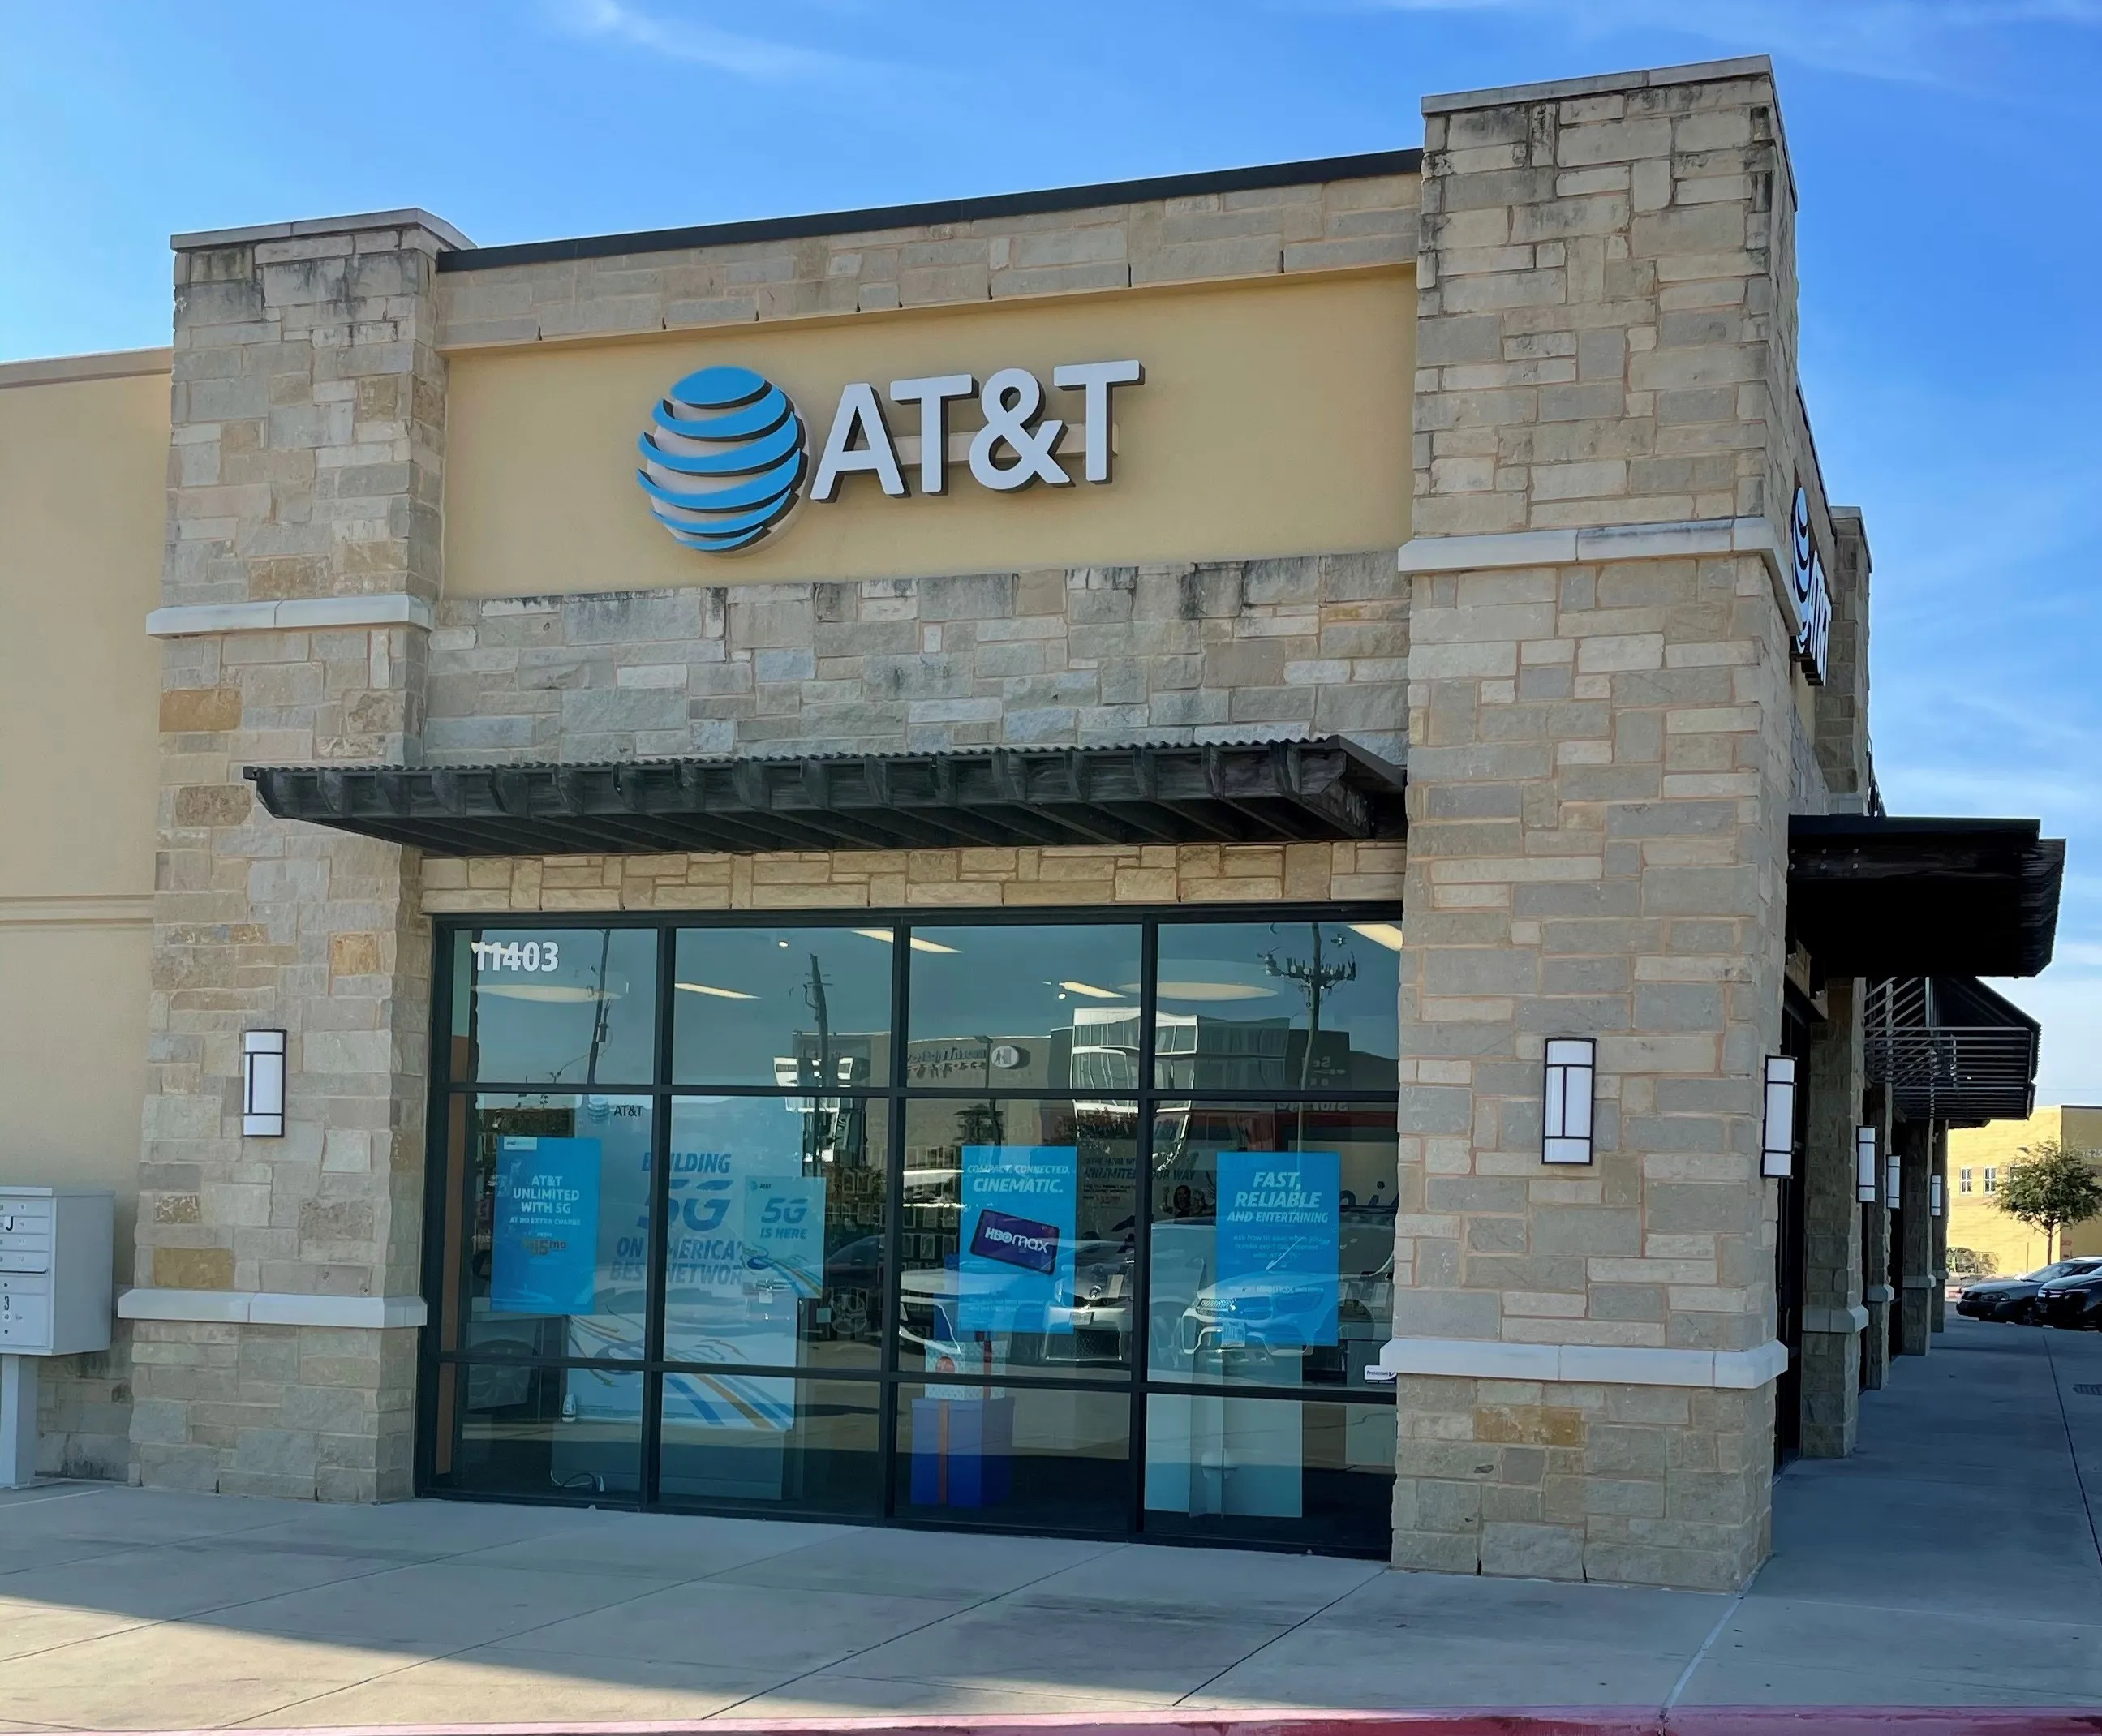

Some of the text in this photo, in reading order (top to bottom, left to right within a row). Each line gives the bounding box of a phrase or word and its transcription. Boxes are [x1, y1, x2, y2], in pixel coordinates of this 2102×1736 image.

[810, 359, 1143, 502] AT&T
[476, 941, 559, 972] 11403
[613, 1105, 643, 1117] AT&T
[642, 1152, 731, 1174] BILDING
[531, 1175, 563, 1187] AT&T
[974, 1178, 1064, 1193] CINEMATIC.
[1253, 1171, 1301, 1191] FAST,
[513, 1188, 580, 1201] UNLIMITED
[1234, 1191, 1322, 1209] RELIABLE
[521, 1201, 571, 1214] WITH 5G
[760, 1197, 809, 1224] 5G
[1227, 1210, 1329, 1223] AND ENTERTAINING
[760, 1227, 808, 1240] IS HERE
[617, 1237, 644, 1258] ON
[609, 1261, 646, 1282] BES
